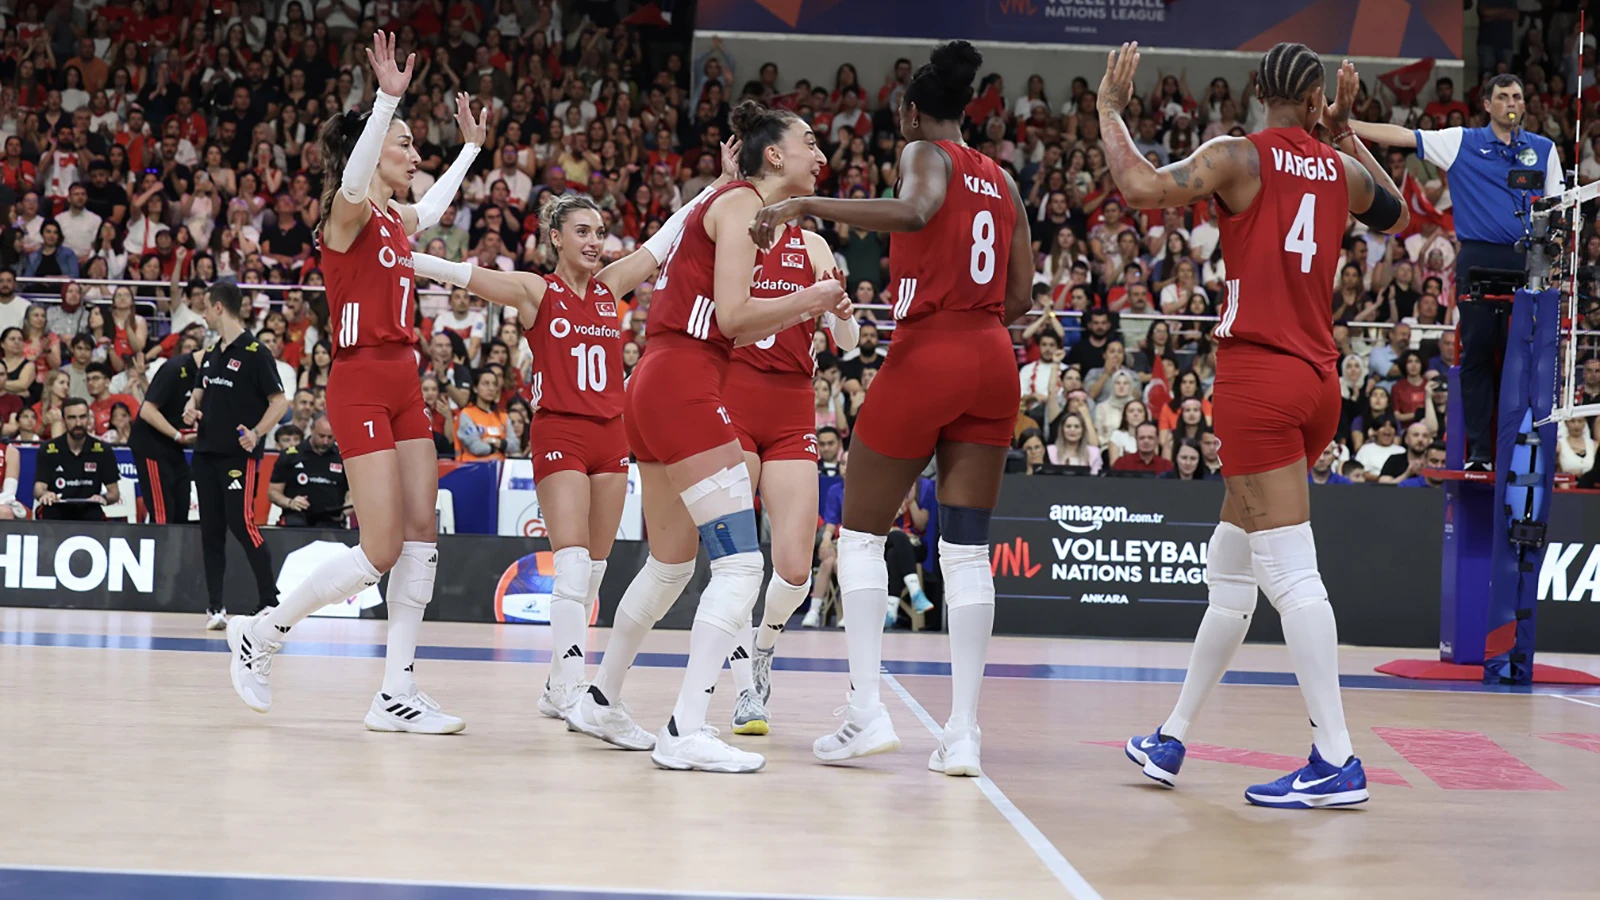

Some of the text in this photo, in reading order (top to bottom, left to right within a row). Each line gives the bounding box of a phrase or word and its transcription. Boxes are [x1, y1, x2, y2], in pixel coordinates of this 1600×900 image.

[1045, 6, 1165, 22] NATIONS LEAGUE
[1271, 147, 1338, 182] VARGAS
[970, 210, 996, 285] 8
[1284, 193, 1318, 273] 4
[400, 276, 411, 328] 7
[571, 342, 607, 393] 10
[363, 420, 375, 438] 7
[1052, 563, 1143, 583] NATIONS
[1536, 542, 1600, 602] KA
[1080, 593, 1129, 604] ANKARA
